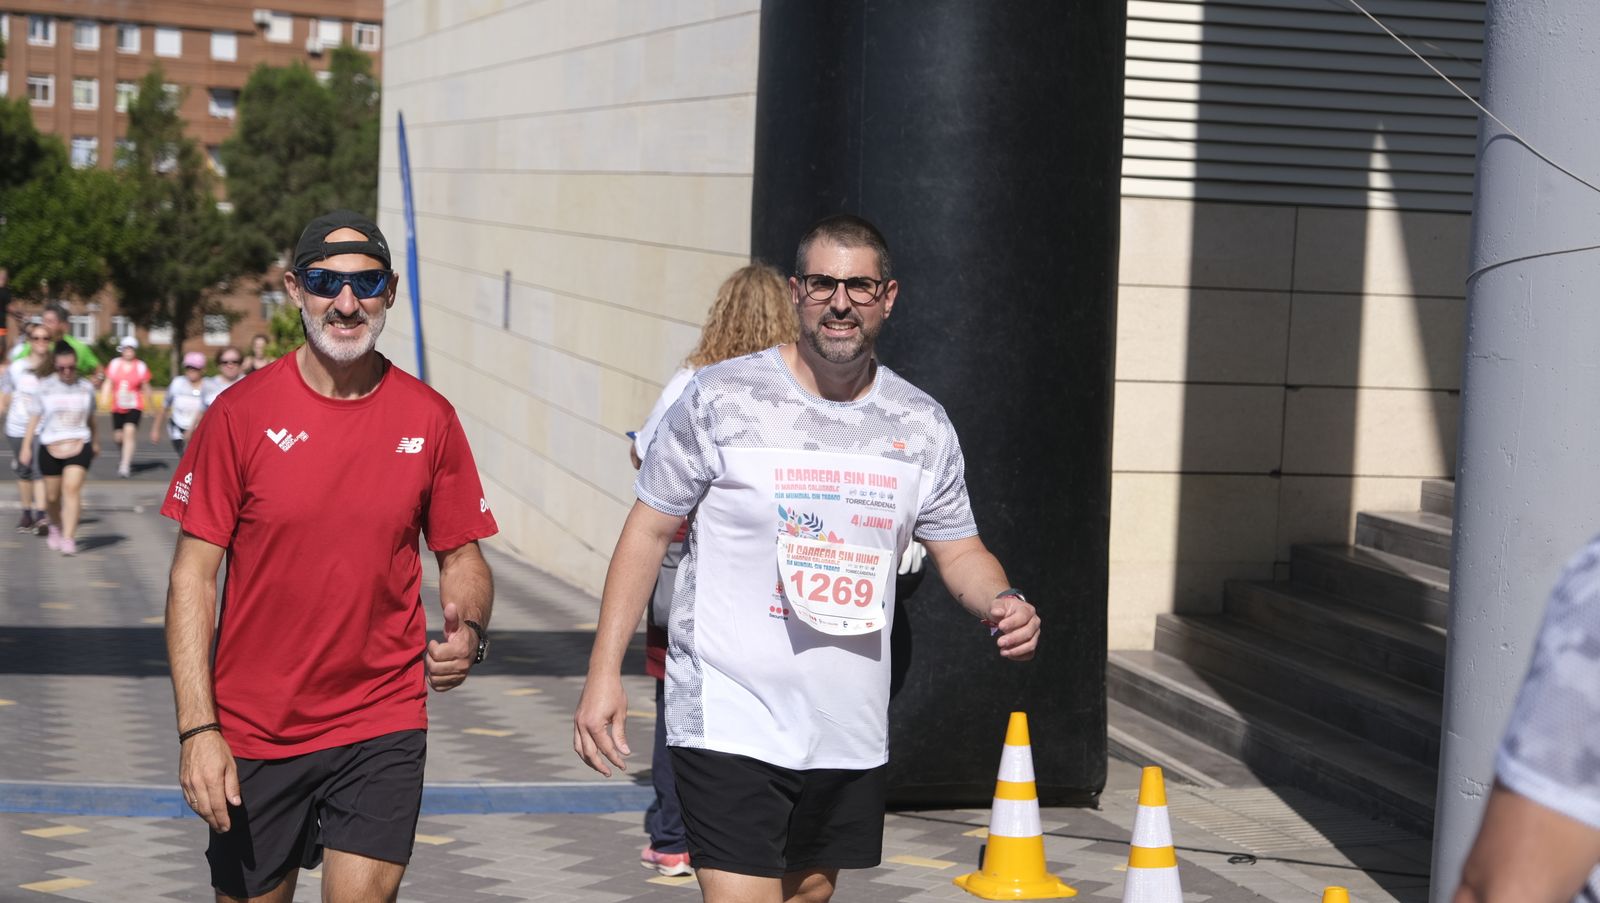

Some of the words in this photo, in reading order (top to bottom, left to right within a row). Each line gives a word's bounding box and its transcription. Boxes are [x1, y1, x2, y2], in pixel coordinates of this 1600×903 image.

[774, 468, 783, 481] II
[787, 469, 841, 484] CARRERA
[843, 471, 865, 485] SIN
[868, 473, 898, 490] HUMO
[845, 497, 896, 510] TORRECÁRDENAS
[796, 544, 837, 560] CARRERA
[838, 550, 855, 562] SIN
[855, 552, 880, 566] HUMO
[790, 570, 874, 608] 1269
